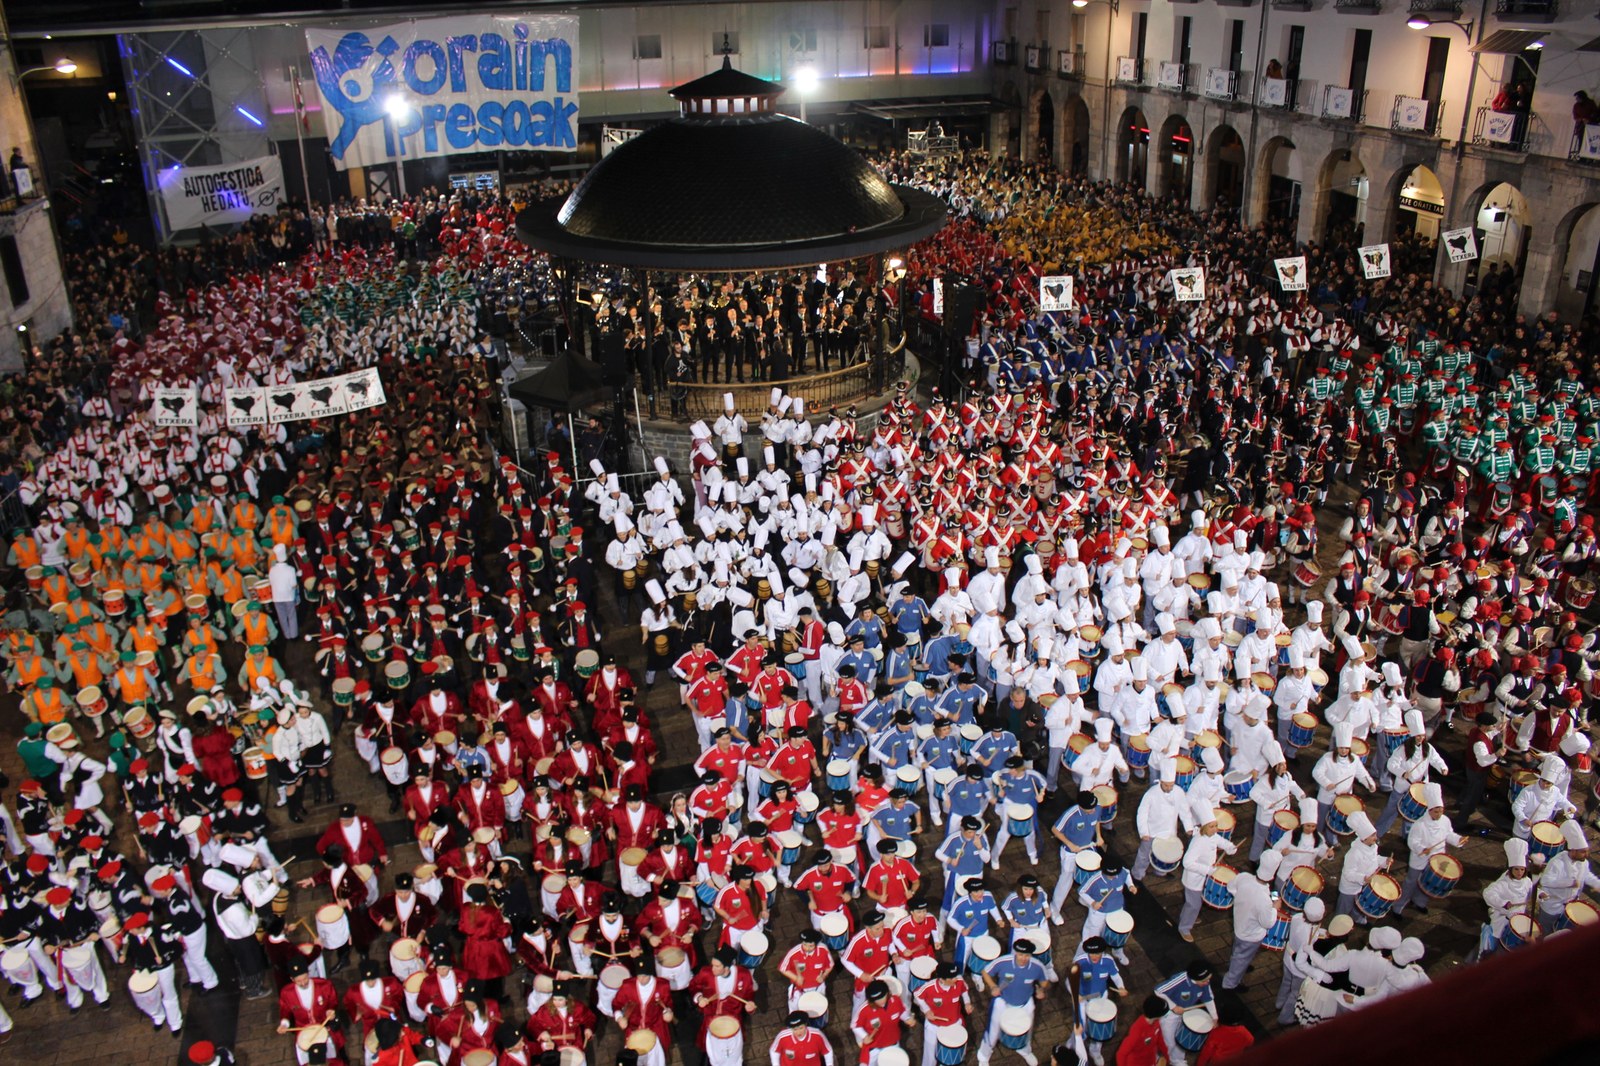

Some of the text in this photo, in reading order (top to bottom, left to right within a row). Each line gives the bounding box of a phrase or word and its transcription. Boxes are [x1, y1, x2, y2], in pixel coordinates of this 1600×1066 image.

[402, 22, 573, 95] orain
[385, 96, 579, 157] presoak
[184, 166, 265, 197] AUTOGESTIOA
[1399, 197, 1412, 206] AFE
[1452, 252, 1475, 262] ETXERA
[311, 406, 344, 417] ETXERA
[230, 416, 265, 424] ETXERA
[272, 412, 306, 422] ETXERA
